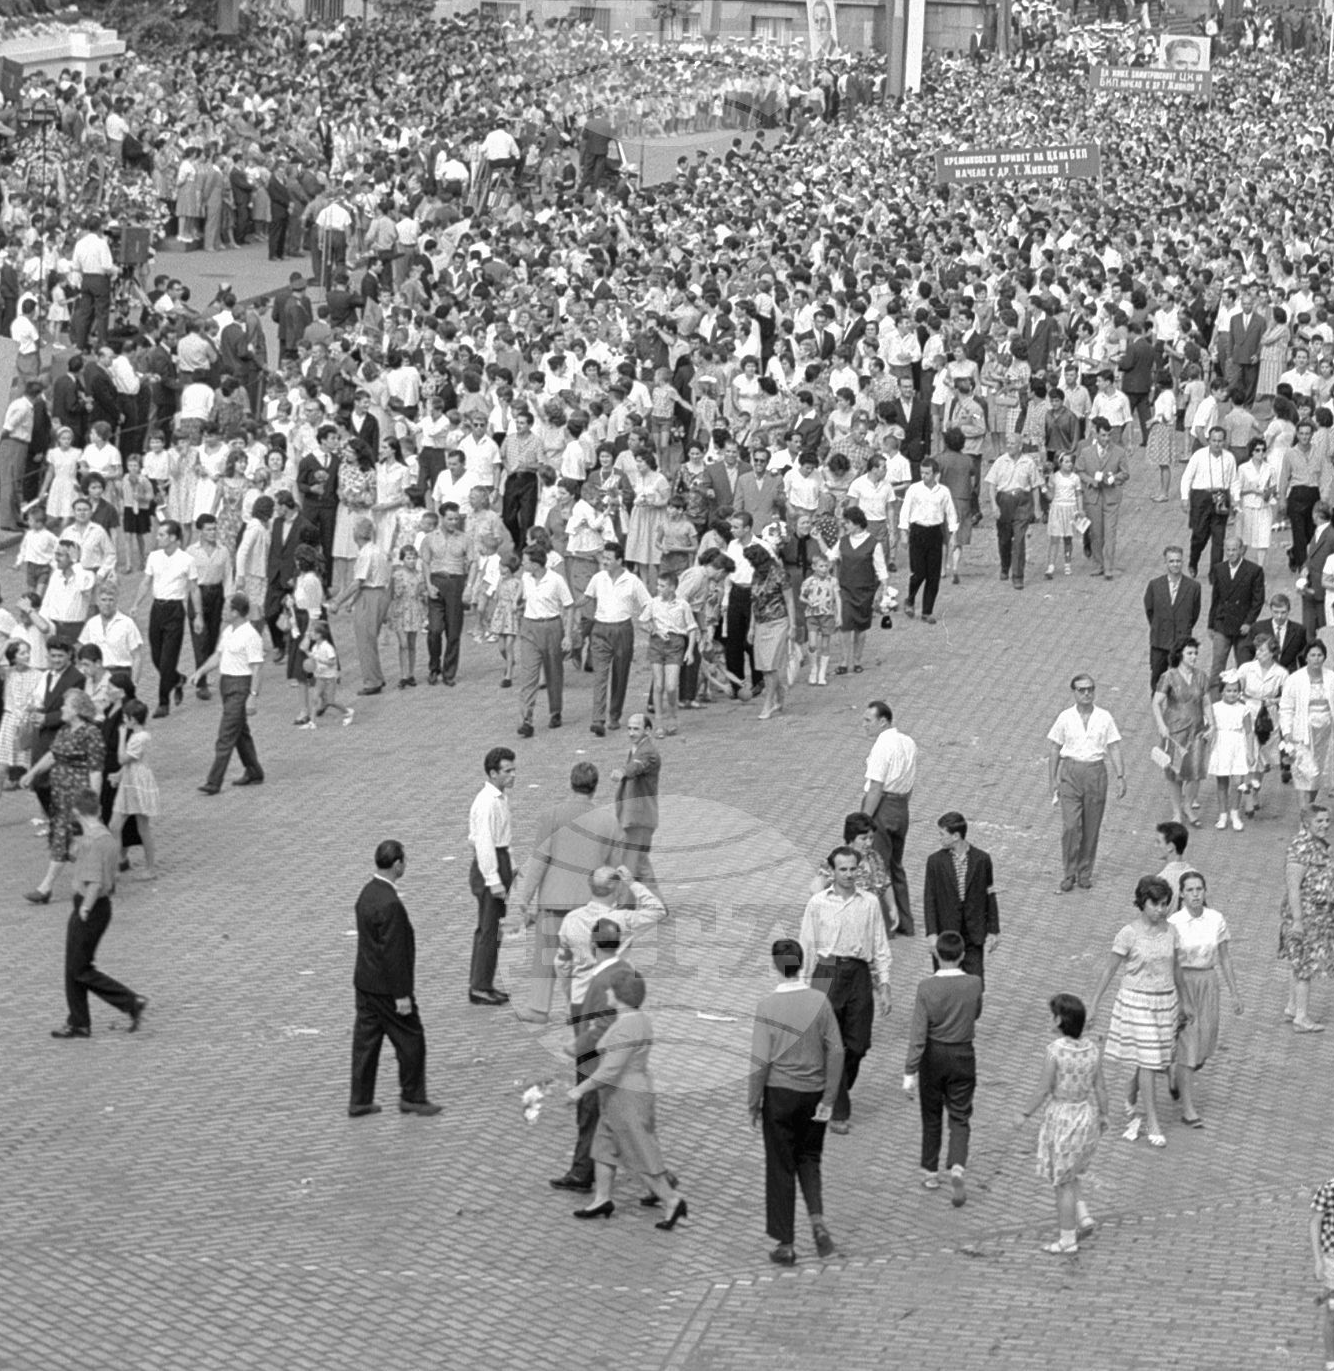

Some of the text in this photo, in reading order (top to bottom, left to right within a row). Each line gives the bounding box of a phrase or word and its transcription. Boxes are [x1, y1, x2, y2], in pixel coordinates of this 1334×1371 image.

[1099, 77, 1118, 87] БКП
[1000, 153, 1030, 163] ПРИВЕТ
[955, 167, 987, 179] НАЧЕЛО
